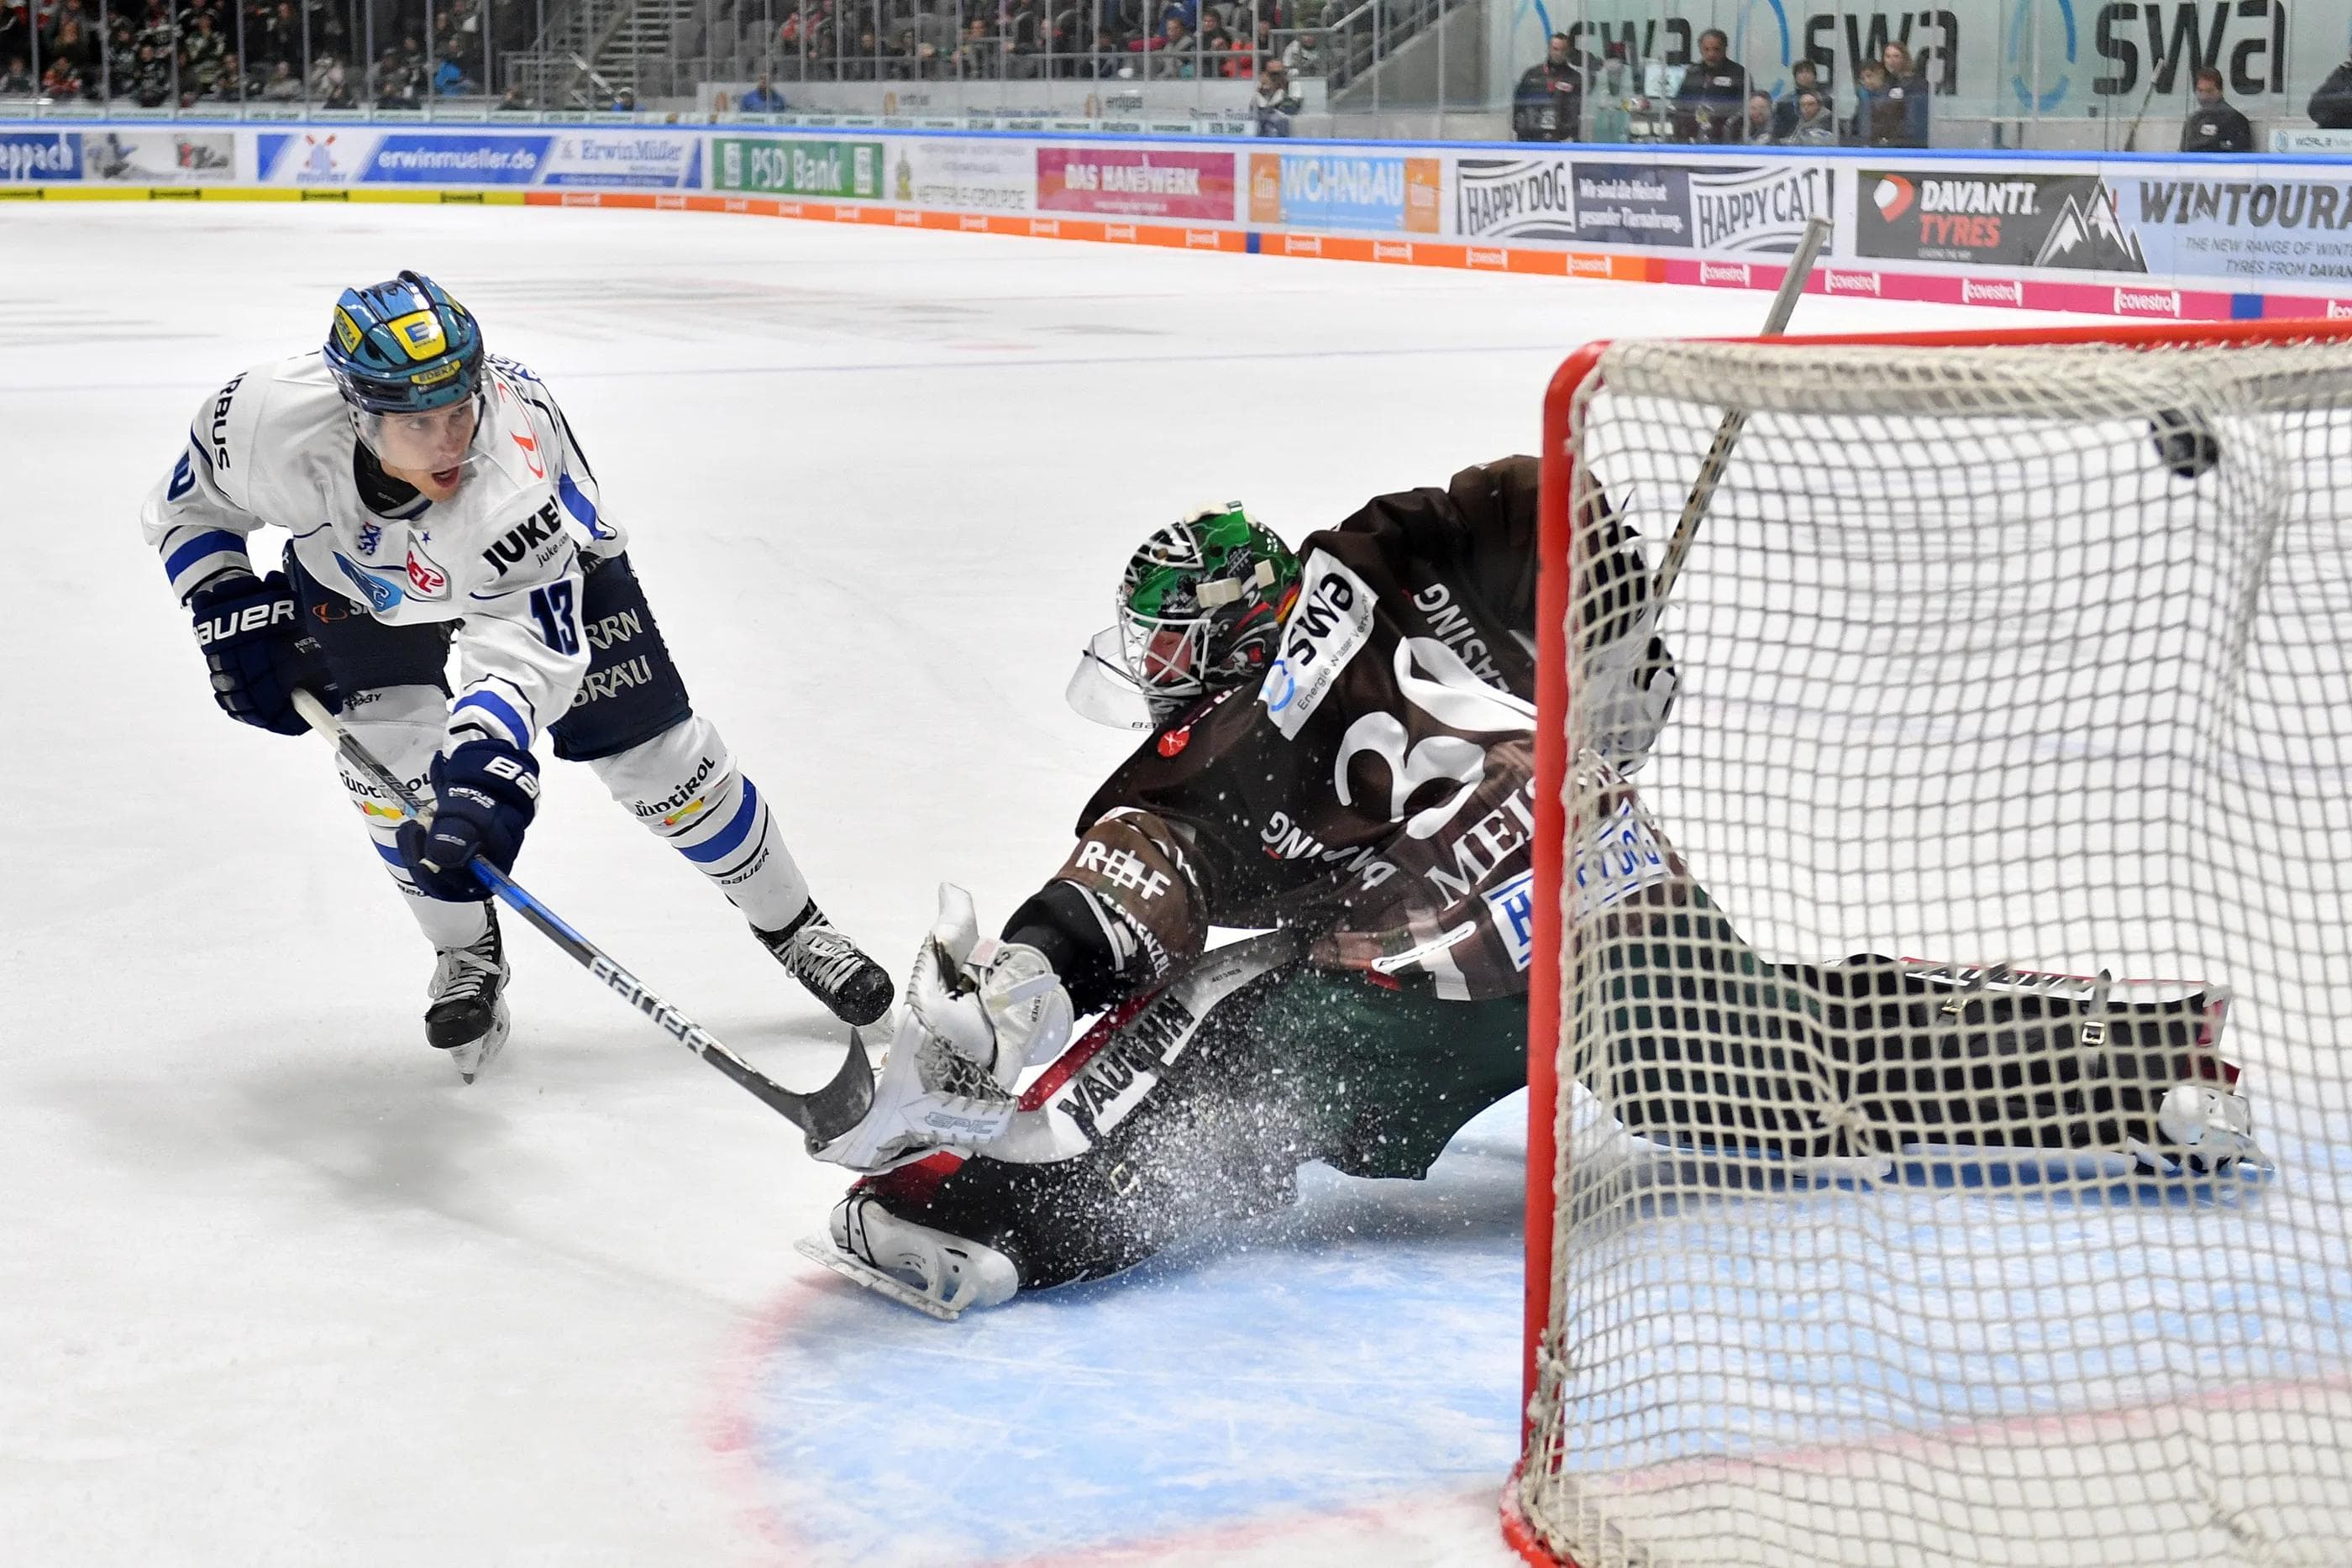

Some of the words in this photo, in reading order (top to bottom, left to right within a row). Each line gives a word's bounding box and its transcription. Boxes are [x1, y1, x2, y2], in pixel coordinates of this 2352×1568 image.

[2092, 0, 2285, 94] swa
[751, 147, 786, 188] PSD
[793, 147, 843, 191] Bank
[1282, 160, 1404, 207] WOHNBAU
[1465, 180, 1525, 236] HAPPY
[1528, 161, 1567, 212] DOG
[1697, 187, 1767, 249] HAPPY
[1772, 167, 1818, 223] CAT
[1919, 213, 2002, 249] TYRES
[2186, 235, 2208, 251] THE
[2211, 238, 2241, 253] NEW
[2244, 239, 2292, 255] RANGE
[2293, 241, 2311, 256] OF
[1706, 266, 1746, 281] covestro
[1830, 274, 1874, 291] covestro
[2225, 259, 2265, 275] TYRES
[2270, 260, 2305, 276] FROM
[1968, 282, 2015, 302] covestro
[2119, 294, 2172, 312] covestro
[529, 579, 580, 657] 13
[1287, 573, 1353, 667] swa
[1297, 667, 1331, 711] Energie
[1331, 637, 1353, 667] Wasser
[925, 1111, 999, 1134] EPIC
